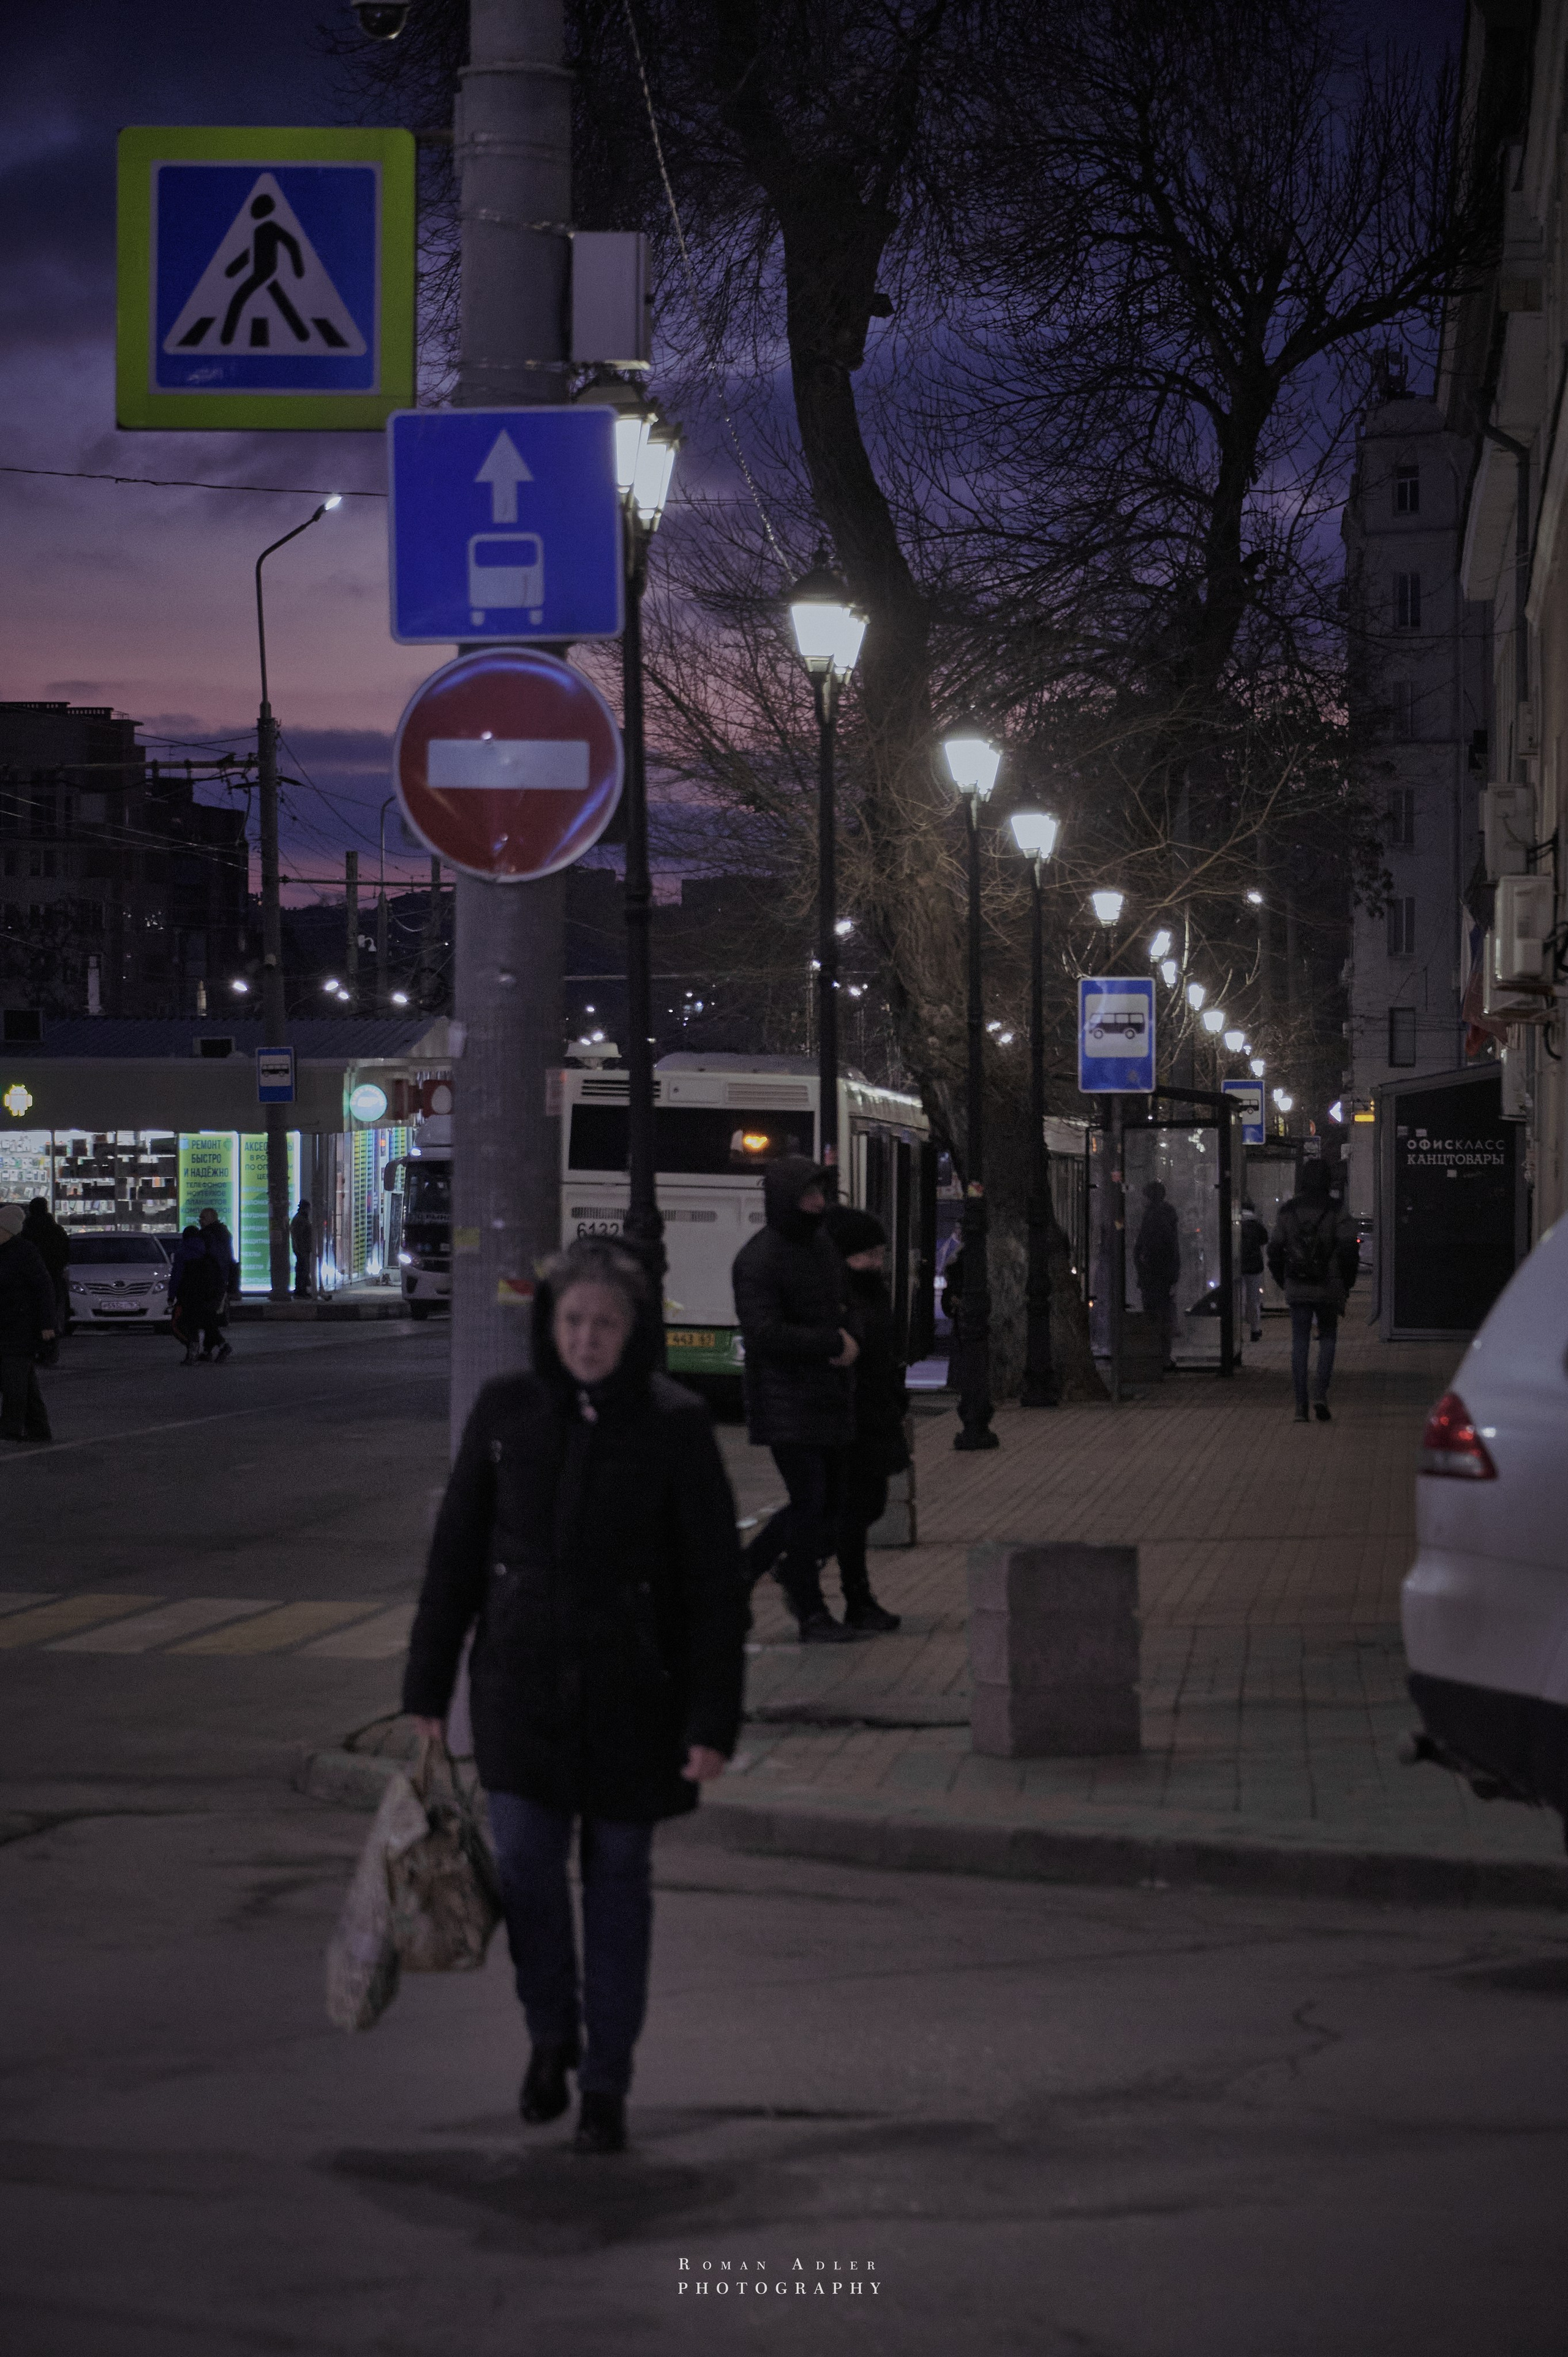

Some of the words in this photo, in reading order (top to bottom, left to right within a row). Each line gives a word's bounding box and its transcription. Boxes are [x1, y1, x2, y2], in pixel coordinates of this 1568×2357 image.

[192, 1140, 221, 1149] РЕМОНТ
[191, 1154, 221, 1163] БЫСТРО
[1406, 1153, 1505, 1166] КАНЦТОВАРЫ
[184, 1168, 189, 1177] И
[190, 1166, 228, 1177] НАДЁЖНО
